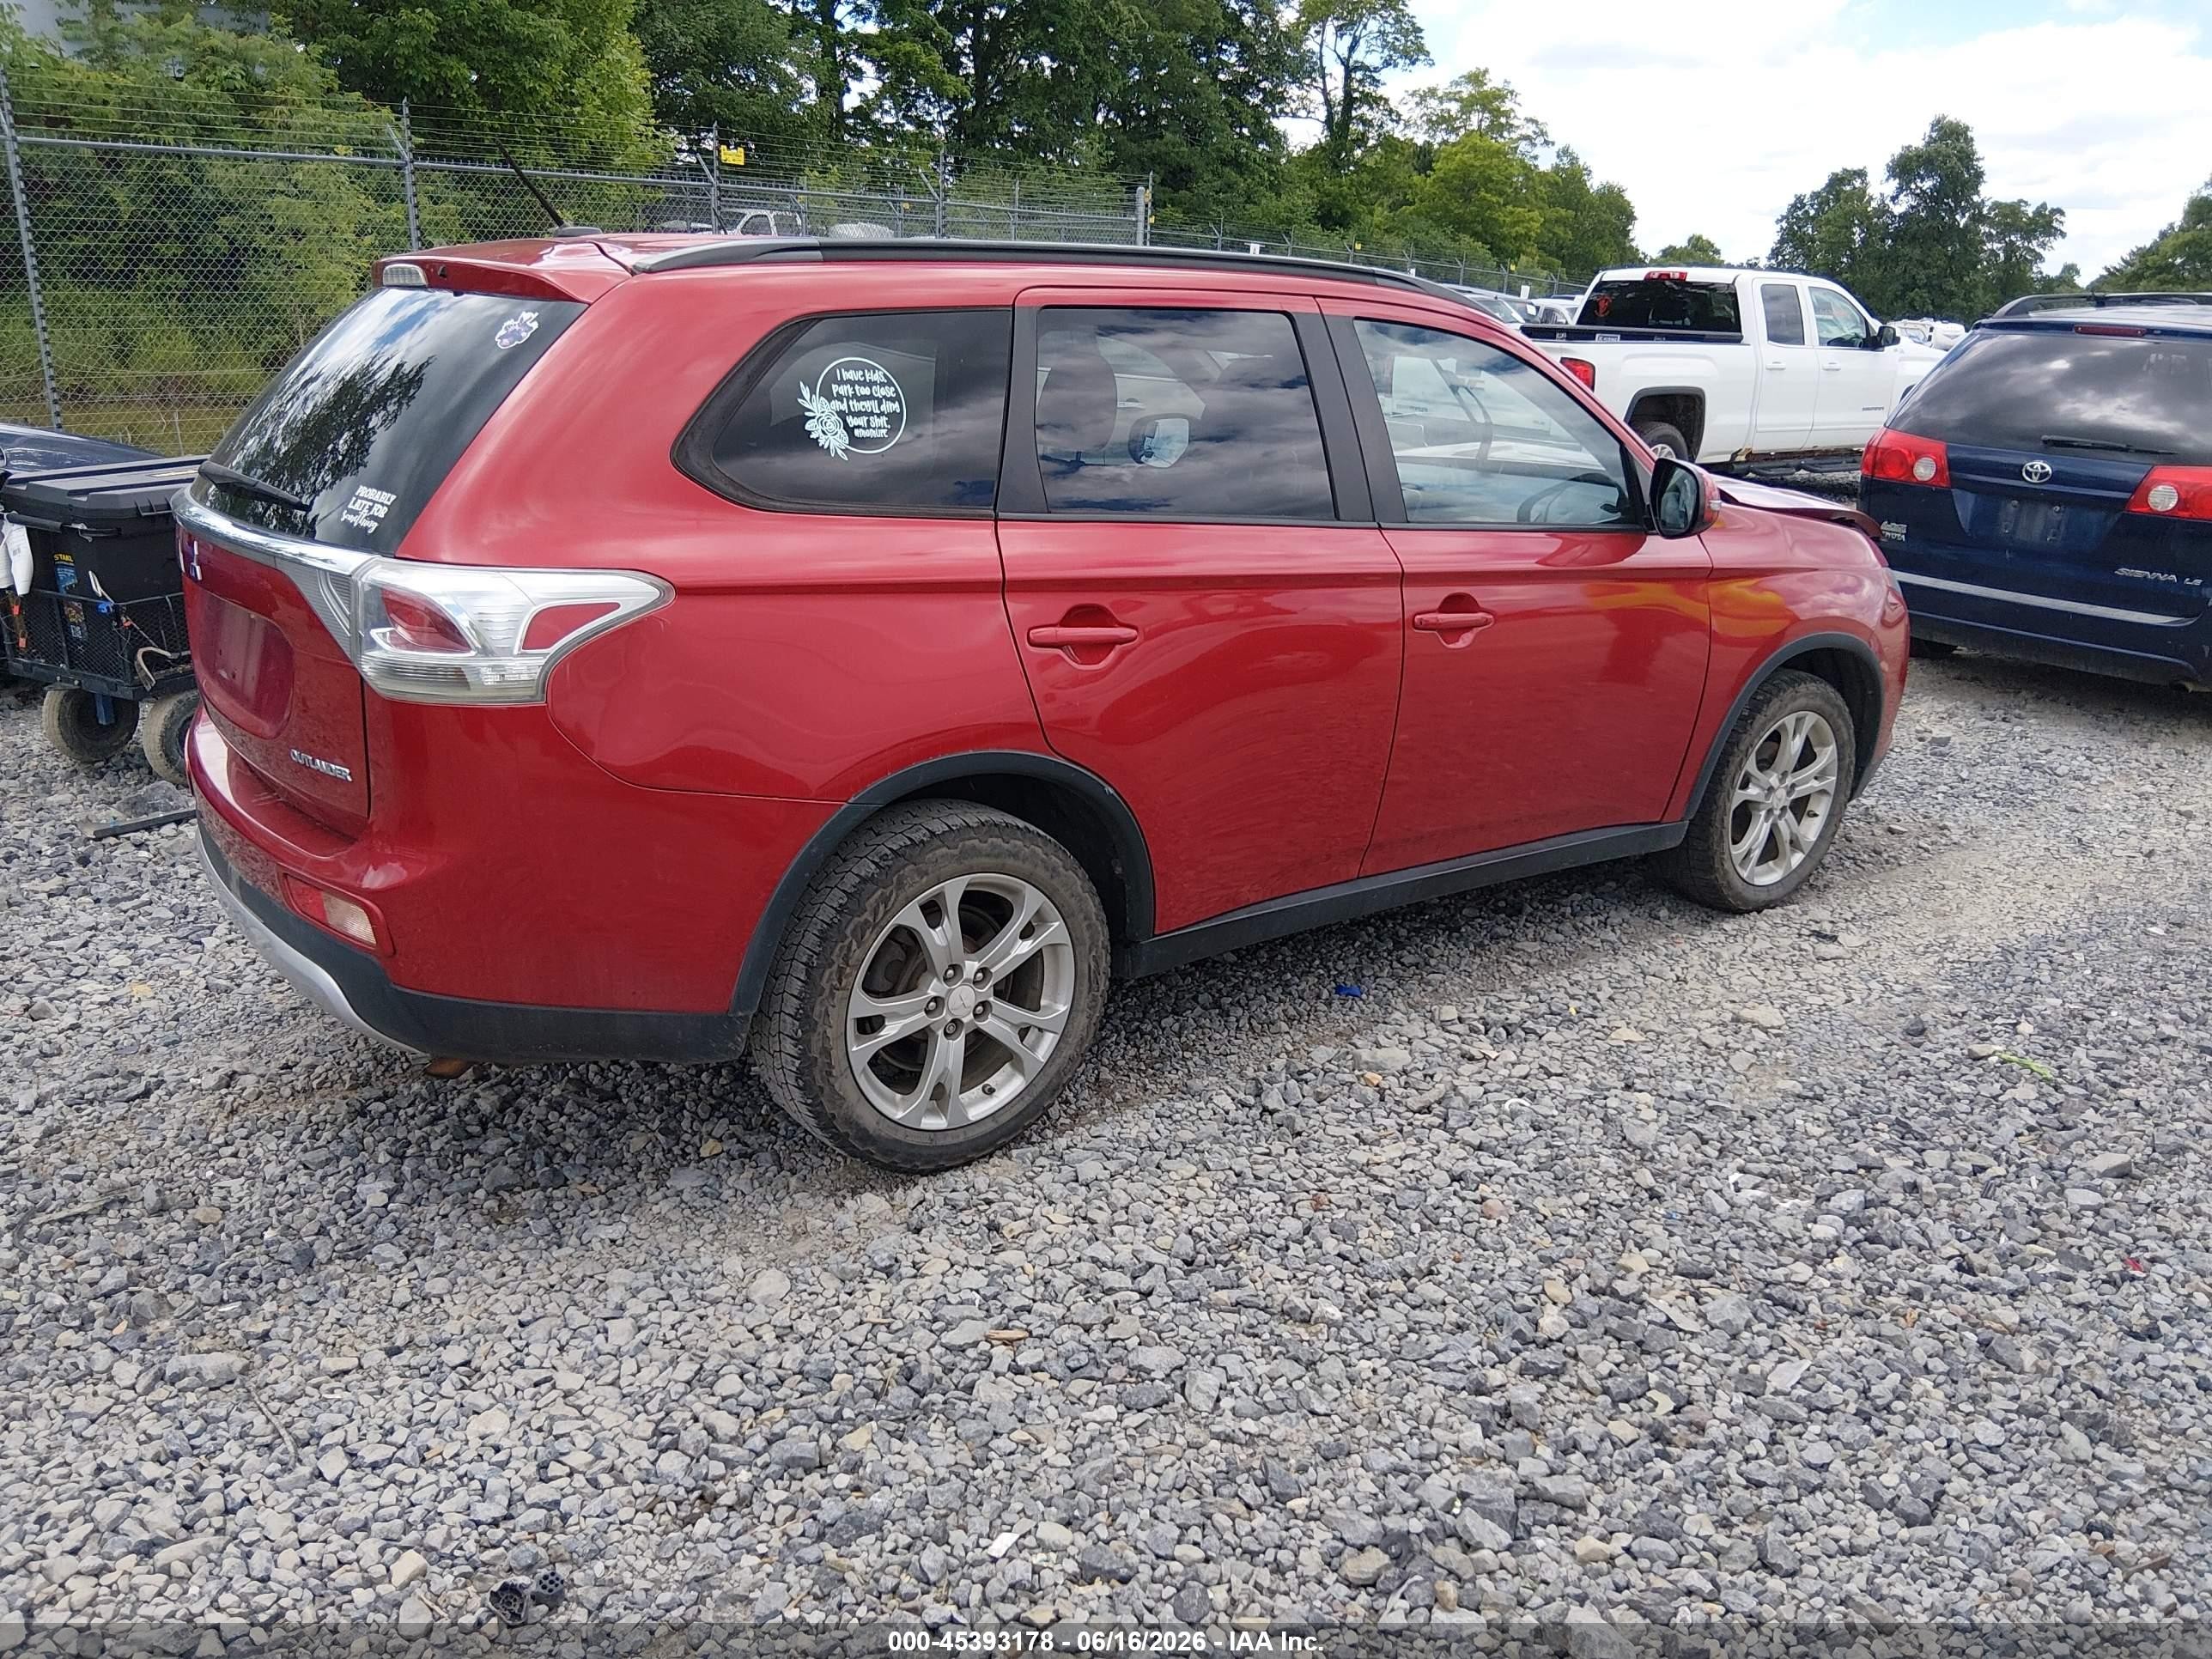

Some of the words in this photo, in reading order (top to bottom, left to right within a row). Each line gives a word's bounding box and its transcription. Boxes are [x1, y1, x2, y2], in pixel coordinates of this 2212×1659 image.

[836, 368, 841, 381] I
[842, 368, 865, 381] have
[865, 368, 888, 384] kids.
[854, 384, 871, 397] too
[872, 384, 896, 398] close
[830, 397, 848, 414] and
[880, 398, 901, 415] ding
[846, 415, 868, 428] your
[869, 415, 891, 429] shit.
[355, 484, 398, 506] PROBABLY
[347, 496, 374, 516] LATE
[369, 502, 389, 519] FOR
[2114, 568, 2177, 583] SIENNA
[2184, 577, 2203, 586] LE
[290, 748, 353, 782] OUTLANDER
